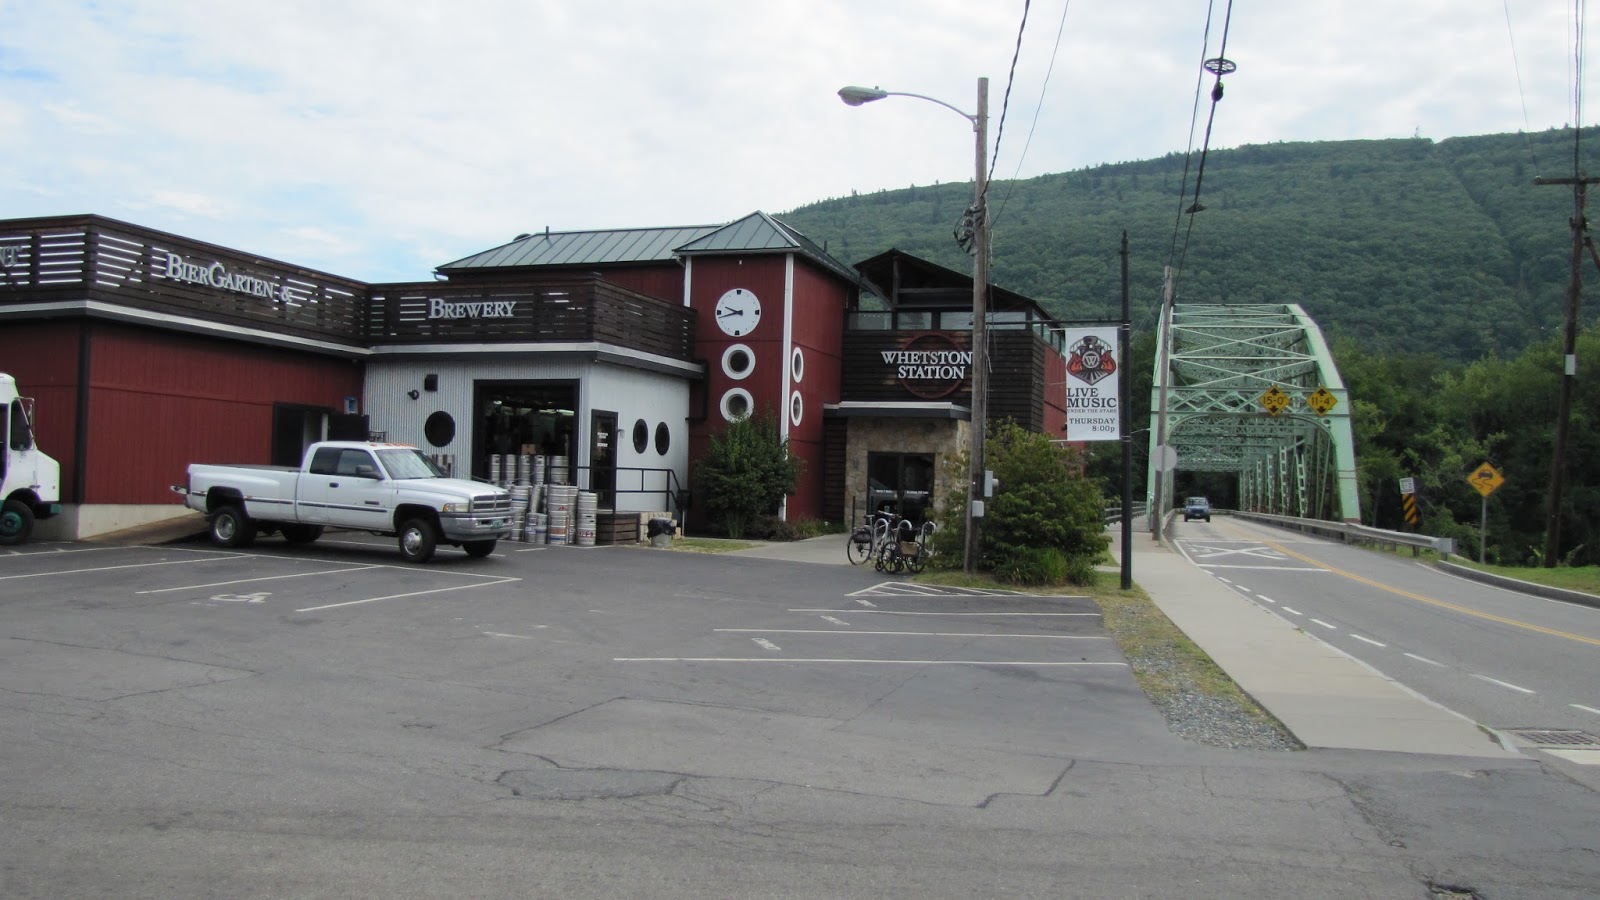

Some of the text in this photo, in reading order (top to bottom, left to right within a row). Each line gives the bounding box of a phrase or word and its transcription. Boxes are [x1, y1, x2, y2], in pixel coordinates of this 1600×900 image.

[280, 285, 293, 302] &
[881, 350, 973, 365] WHETSTON
[898, 366, 965, 380] STATION
[1067, 387, 1098, 398] LIVE
[1067, 397, 1117, 408] MUSIC
[1069, 417, 1116, 425] THURSDAY
[1092, 425, 1116, 433] 8:00p
